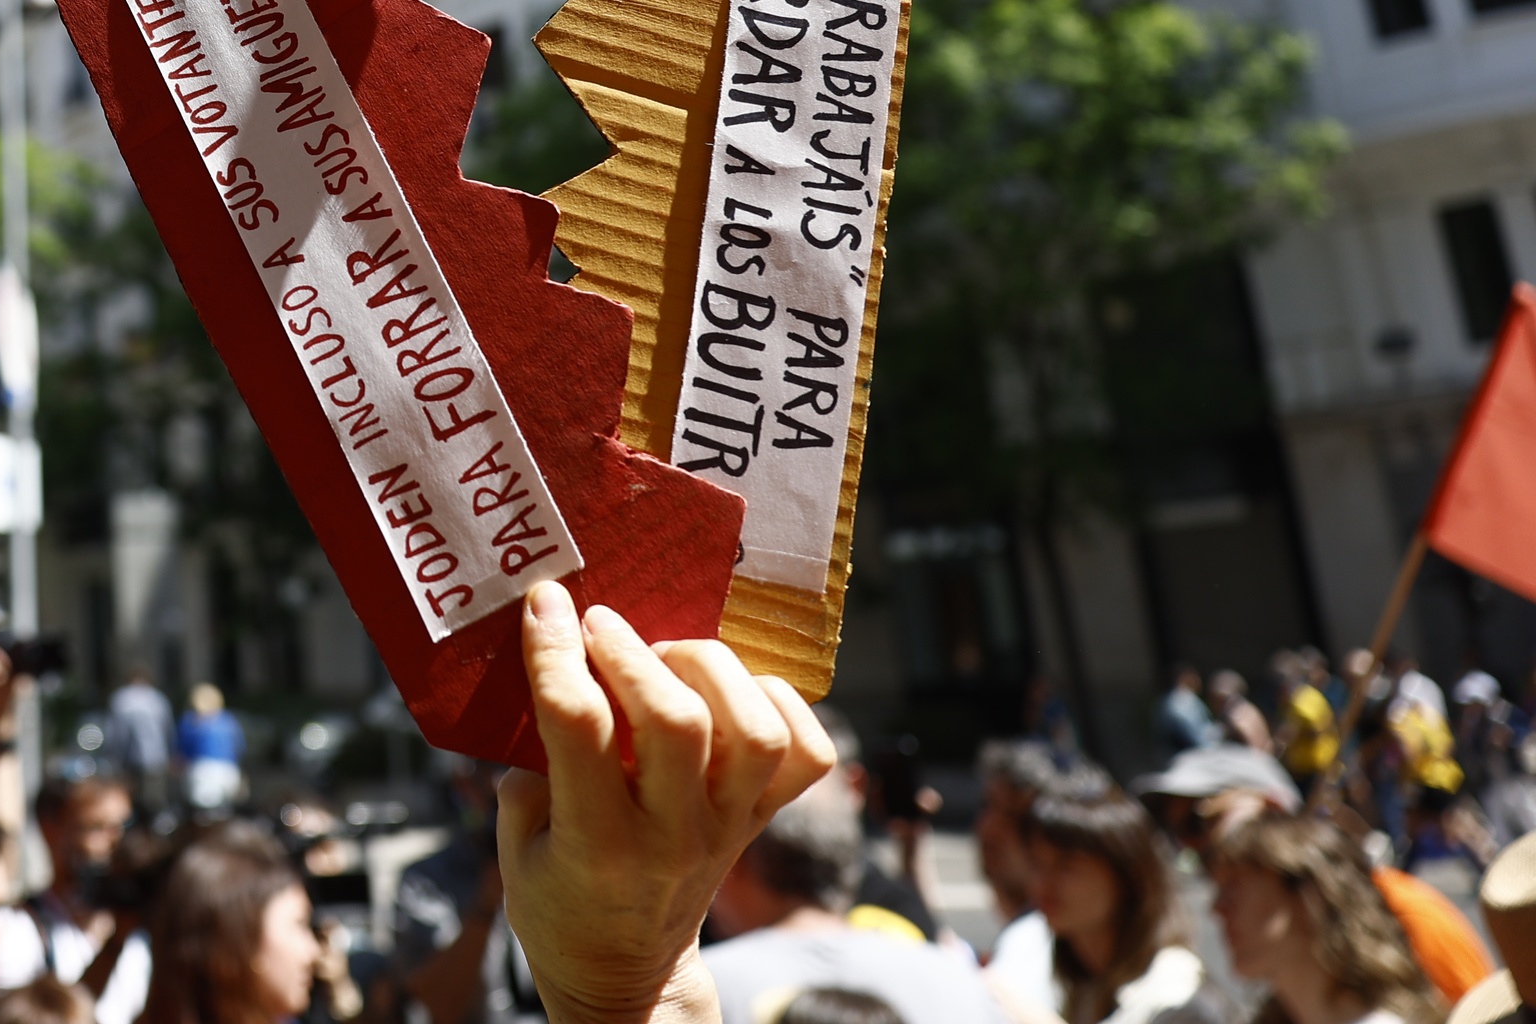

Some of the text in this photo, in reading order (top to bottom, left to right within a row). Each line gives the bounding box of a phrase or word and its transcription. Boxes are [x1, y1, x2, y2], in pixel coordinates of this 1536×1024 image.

[217, 157, 280, 231] SUS
[304, 123, 369, 196] SUS
[725, 144, 775, 176] A
[341, 191, 393, 223] A
[716, 196, 773, 277] LOS
[262, 237, 305, 269] A
[281, 285, 388, 450] INCLUSO
[346, 229, 497, 442] FORRAR
[771, 307, 849, 449] PARA
[368, 462, 474, 618] JODEN
[459, 440, 559, 576] PARA
